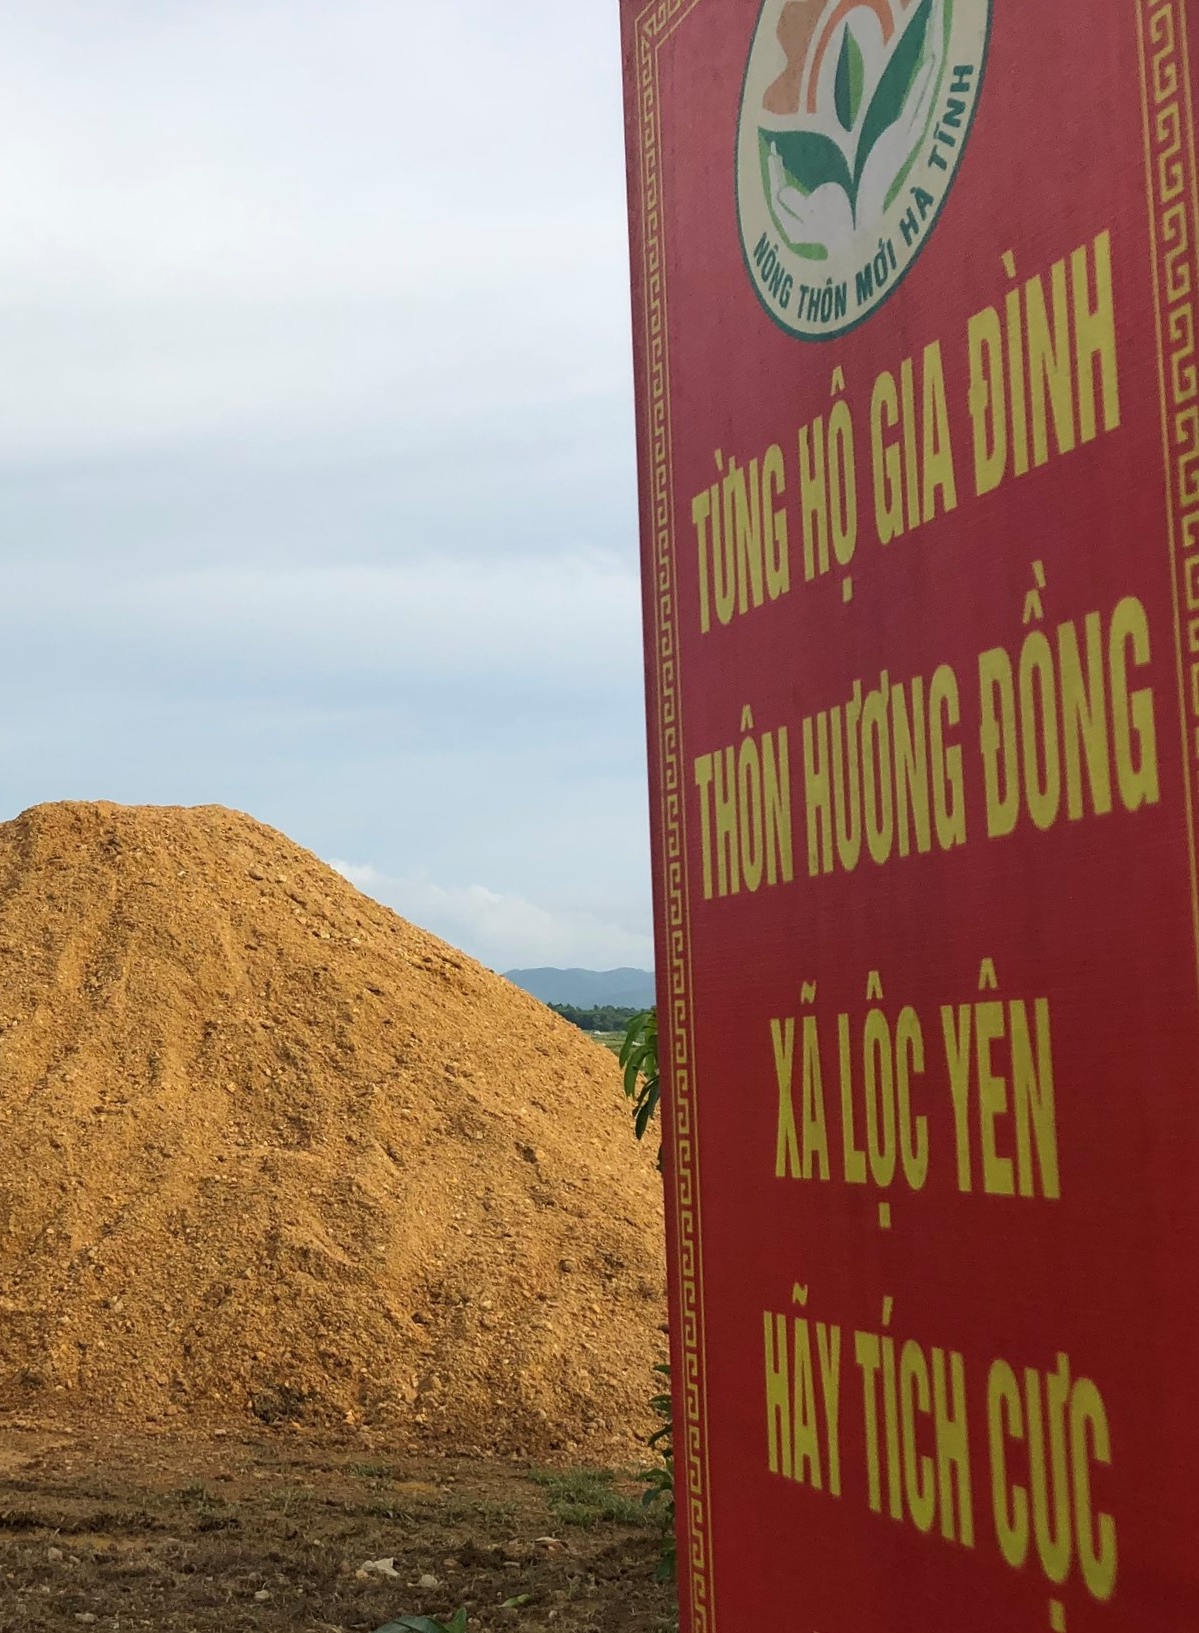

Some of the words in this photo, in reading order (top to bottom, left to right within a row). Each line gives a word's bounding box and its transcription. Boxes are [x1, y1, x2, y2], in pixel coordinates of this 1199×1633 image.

[753, 232, 794, 309] NÔNG
[797, 277, 848, 323] THÔN
[855, 237, 897, 306] MỚI
[899, 186, 934, 246] HÀ
[928, 64, 974, 171] TĨNH
[692, 445, 790, 633] TỪNG
[799, 367, 857, 602] HỘ
[871, 340, 956, 546] GIA
[967, 230, 1121, 497] ĐÌNH
[694, 705, 794, 900] THÔN
[802, 664, 968, 871] HƯƠNG
[978, 560, 1160, 838] ĐỒNG
[770, 981, 830, 1180] XÃ
[838, 971, 929, 1228] LỘC
[940, 957, 1061, 1200] YÊN
[763, 1284, 842, 1497] HÃY
[855, 1296, 974, 1548] TÍCH
[987, 1353, 1117, 1633] CỰC
